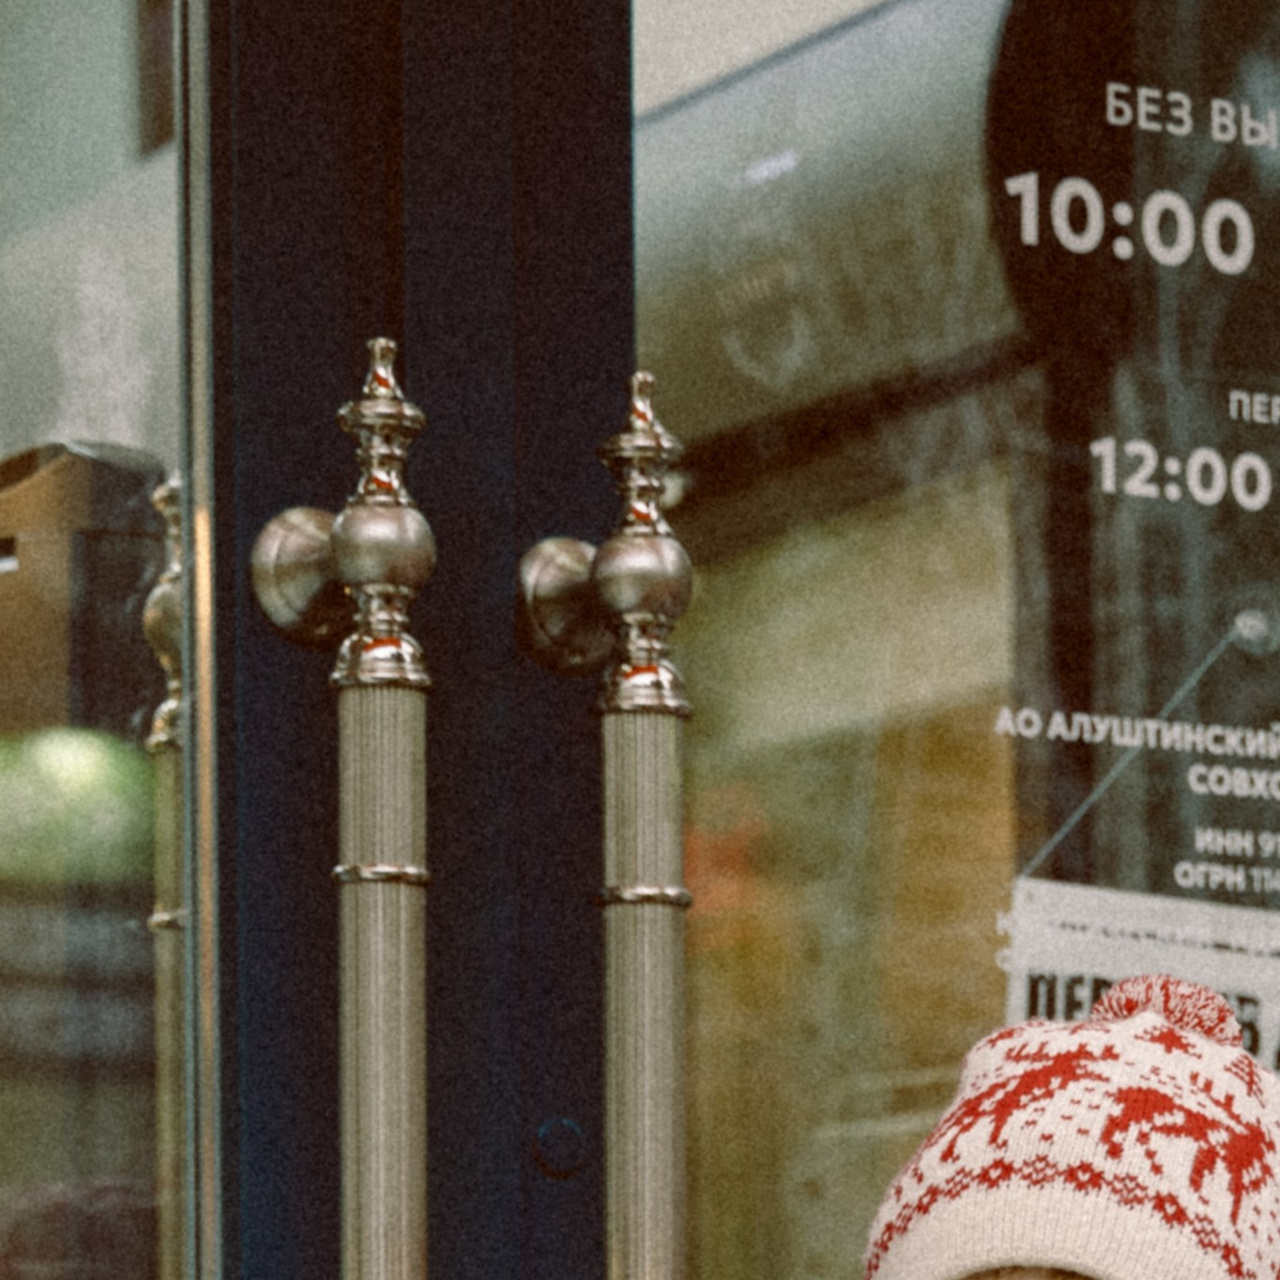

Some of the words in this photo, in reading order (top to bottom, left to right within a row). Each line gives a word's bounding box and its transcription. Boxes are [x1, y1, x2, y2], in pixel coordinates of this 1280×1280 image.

[1106, 82, 1193, 136] БЕЗ
[1004, 171, 1255, 275] 10:00
[1090, 437, 1272, 511] 12:00
[995, 706, 1042, 739] АО
[1194, 826, 1254, 857] ИНН
[1173, 860, 1247, 892] ОГРН
